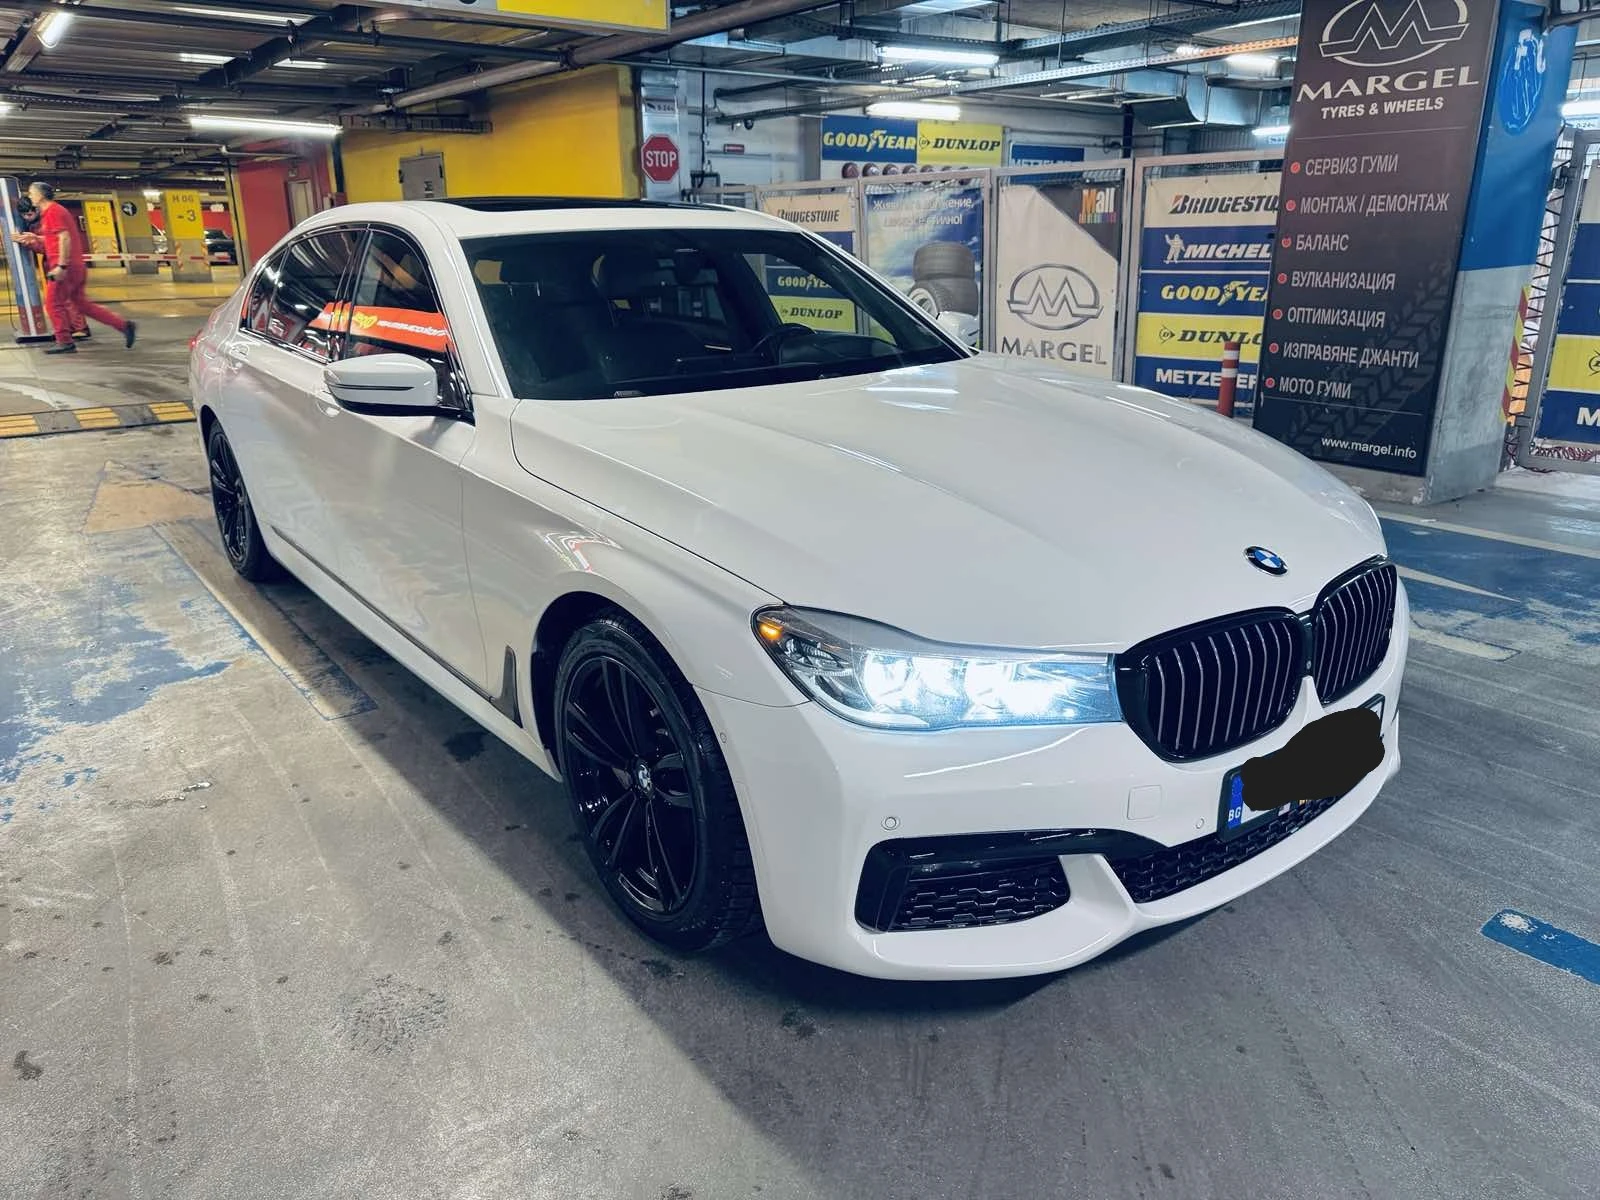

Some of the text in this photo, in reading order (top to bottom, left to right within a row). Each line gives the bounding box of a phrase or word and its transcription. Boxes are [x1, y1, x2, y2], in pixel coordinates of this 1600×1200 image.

[1296, 66, 1480, 102] MARGEL
[1321, 97, 1444, 120] TYRES & WHEELS
[933, 137, 1000, 151] DUNLOP
[646, 150, 677, 168] STOP
[1305, 153, 1399, 176] СЕРВИЗ ГУМИ
[1082, 187, 1116, 214] Mall
[1169, 194, 1280, 213] BRIDGESTO
[1300, 195, 1357, 214] МОНТАЖ
[1366, 193, 1449, 216] ДЕМОНТАЖ
[1184, 243, 1271, 259] MICHEL
[1296, 234, 1350, 251] БАЛАНС
[1291, 271, 1396, 294] ВУЛКАНИЗАЦИЯ
[790, 307, 843, 319] DUNLOP
[1287, 307, 1386, 331] ОПТИМИЗАЦИЯ
[1001, 336, 1107, 365] MARGEL
[1283, 341, 1420, 369] ИЗПРАВЯНЕ ДЖАНТИ
[1279, 376, 1351, 399] МОТО ГУМИ
[1321, 436, 1417, 459] www.margel.info
[1228, 806, 1241, 821] BG
